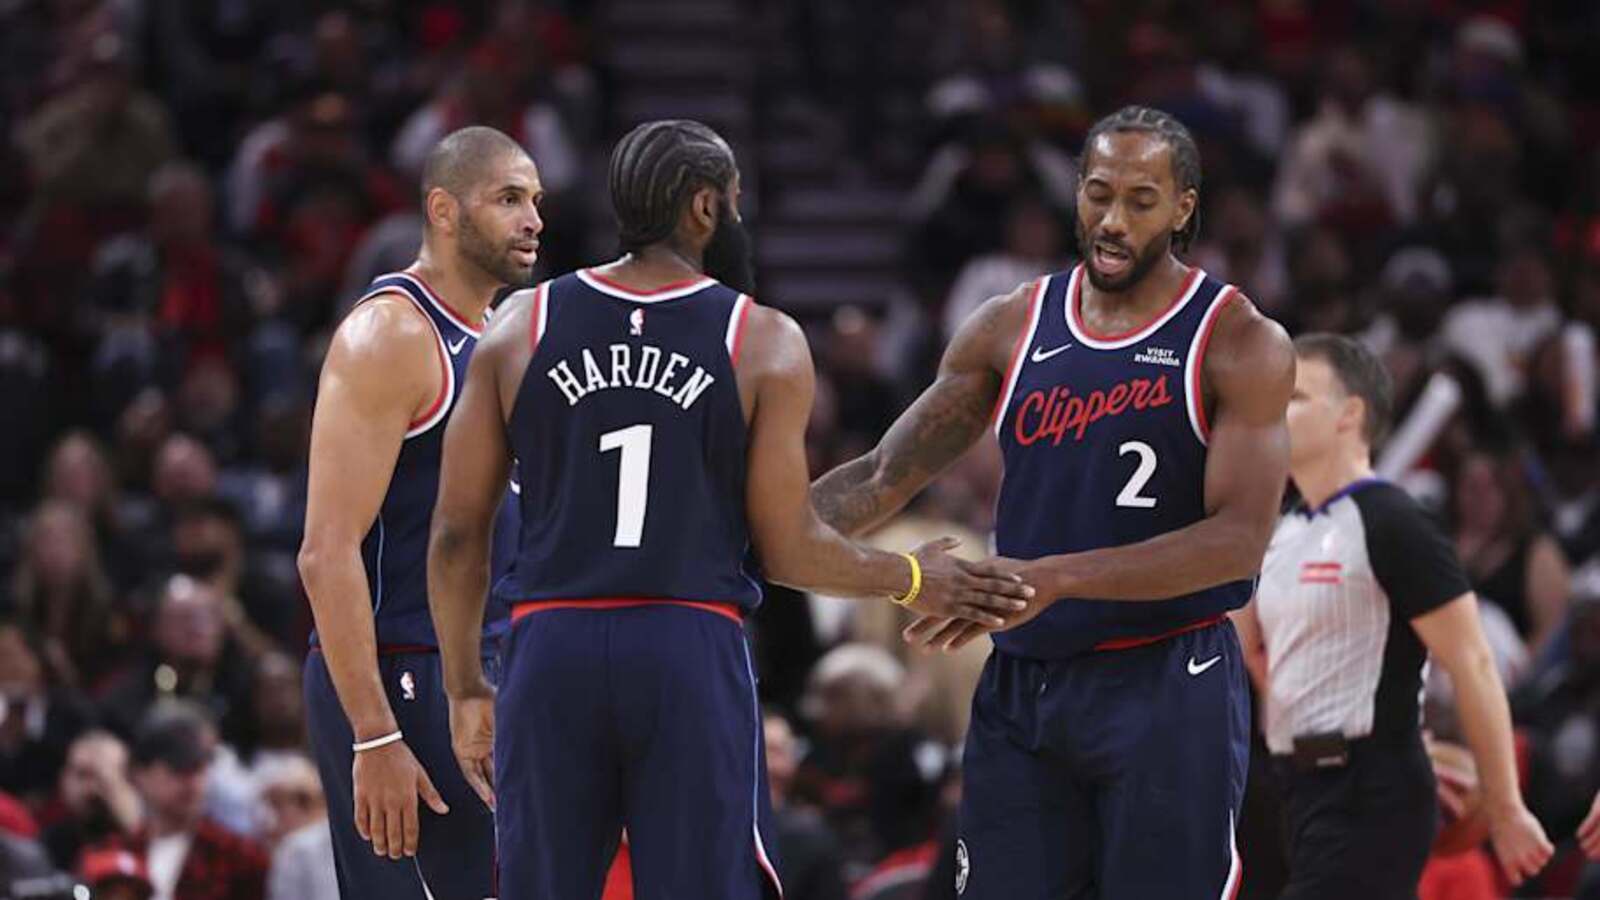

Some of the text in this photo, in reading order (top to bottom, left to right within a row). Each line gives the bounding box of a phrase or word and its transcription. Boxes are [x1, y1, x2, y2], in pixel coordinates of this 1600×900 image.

[547, 343, 715, 410] HARDEN
[1134, 354, 1180, 366] RWANDA
[1147, 347, 1174, 357] VISIT
[1015, 375, 1173, 446] Clippers
[600, 424, 653, 547] 1
[1116, 440, 1158, 508] 2
